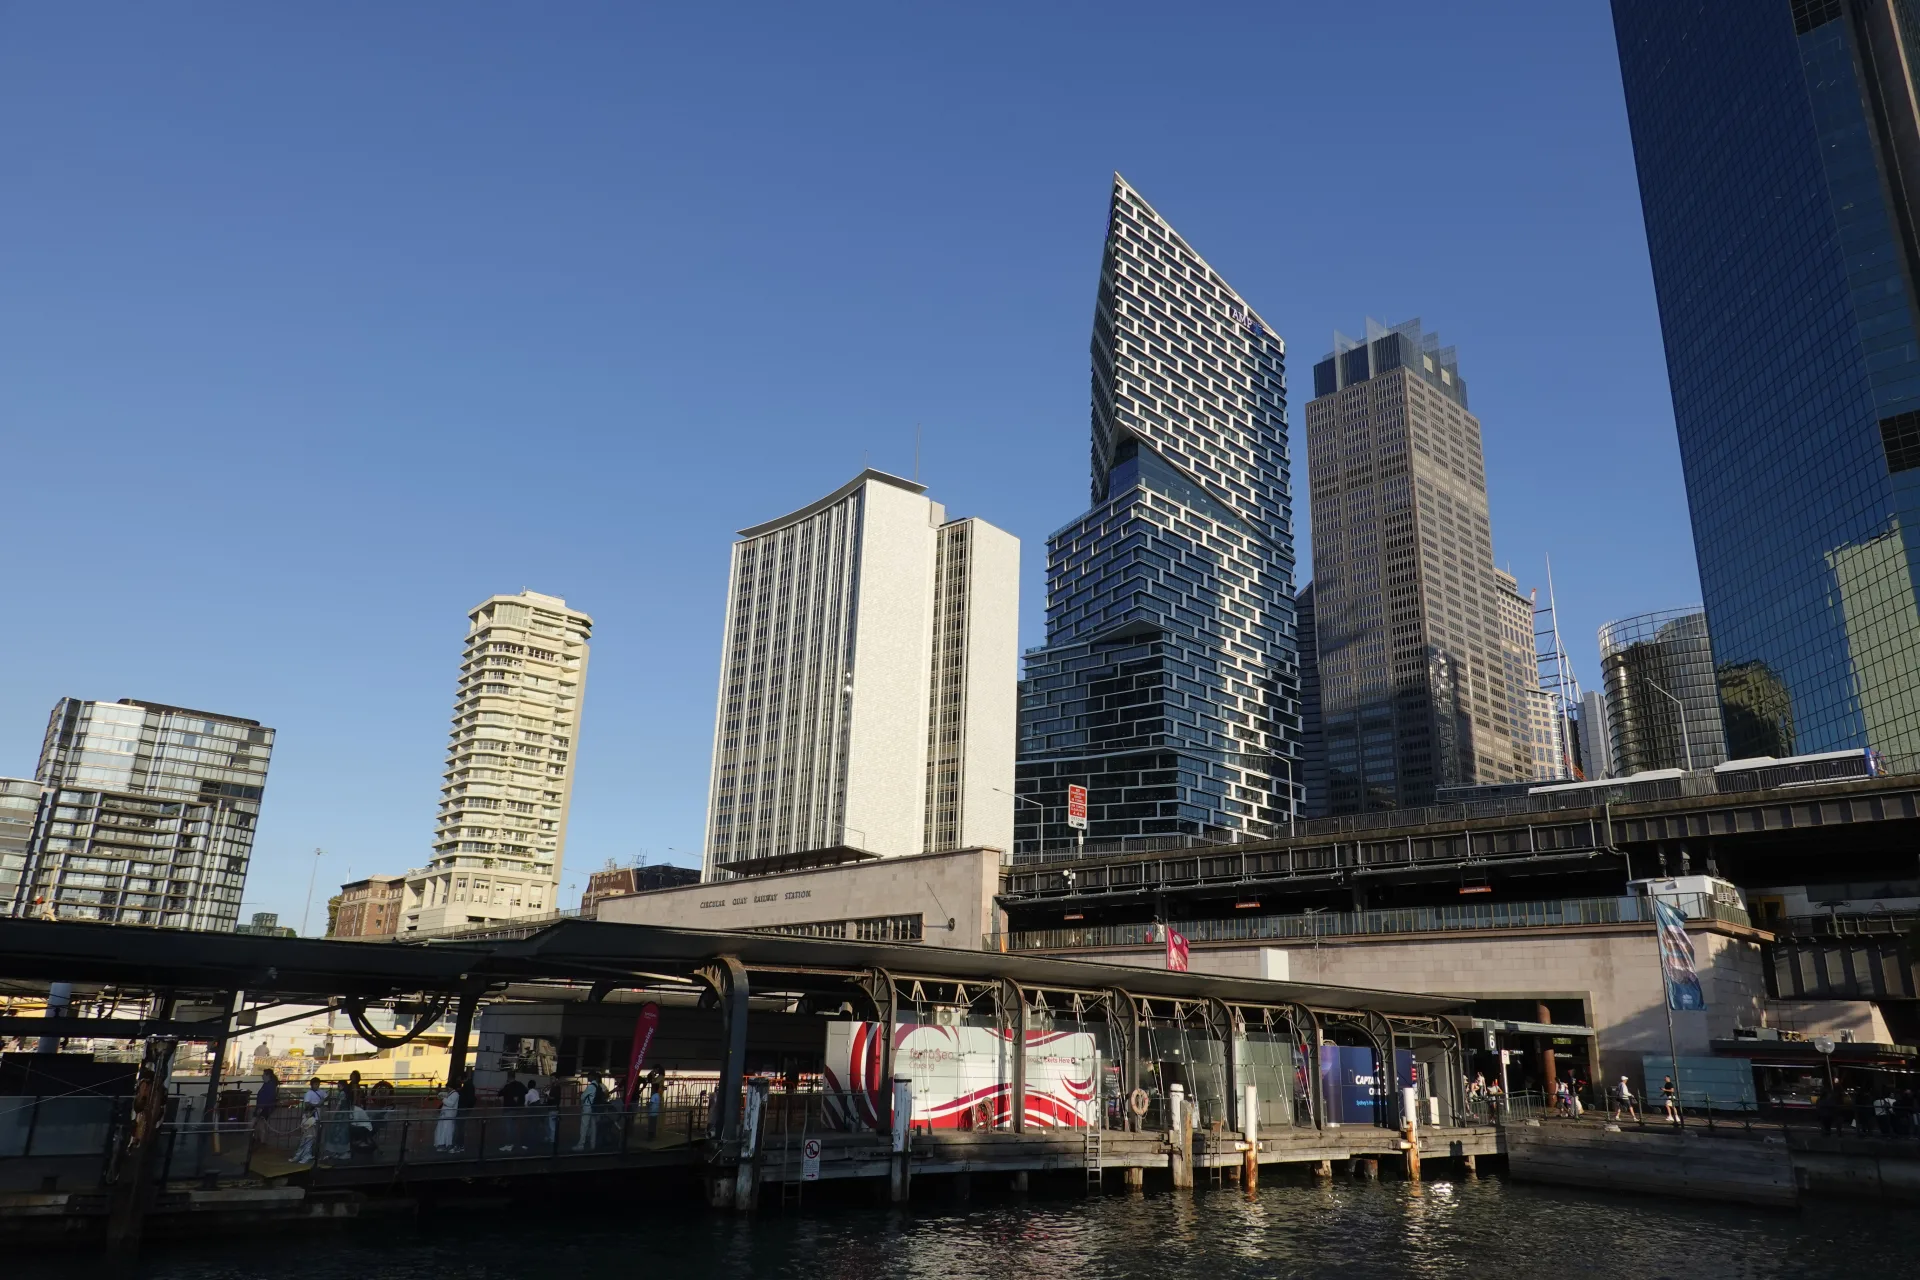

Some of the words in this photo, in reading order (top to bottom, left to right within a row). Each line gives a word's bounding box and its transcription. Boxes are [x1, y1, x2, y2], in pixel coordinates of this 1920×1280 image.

[1232, 308, 1253, 329] AMP
[700, 900, 726, 909] CIRCULAR
[732, 897, 748, 905] QUAY
[754, 894, 778, 903] RAILWAY
[785, 890, 811, 900] STATION
[635, 1026, 654, 1071] Sightseeing
[1490, 1035, 1495, 1048] 6
